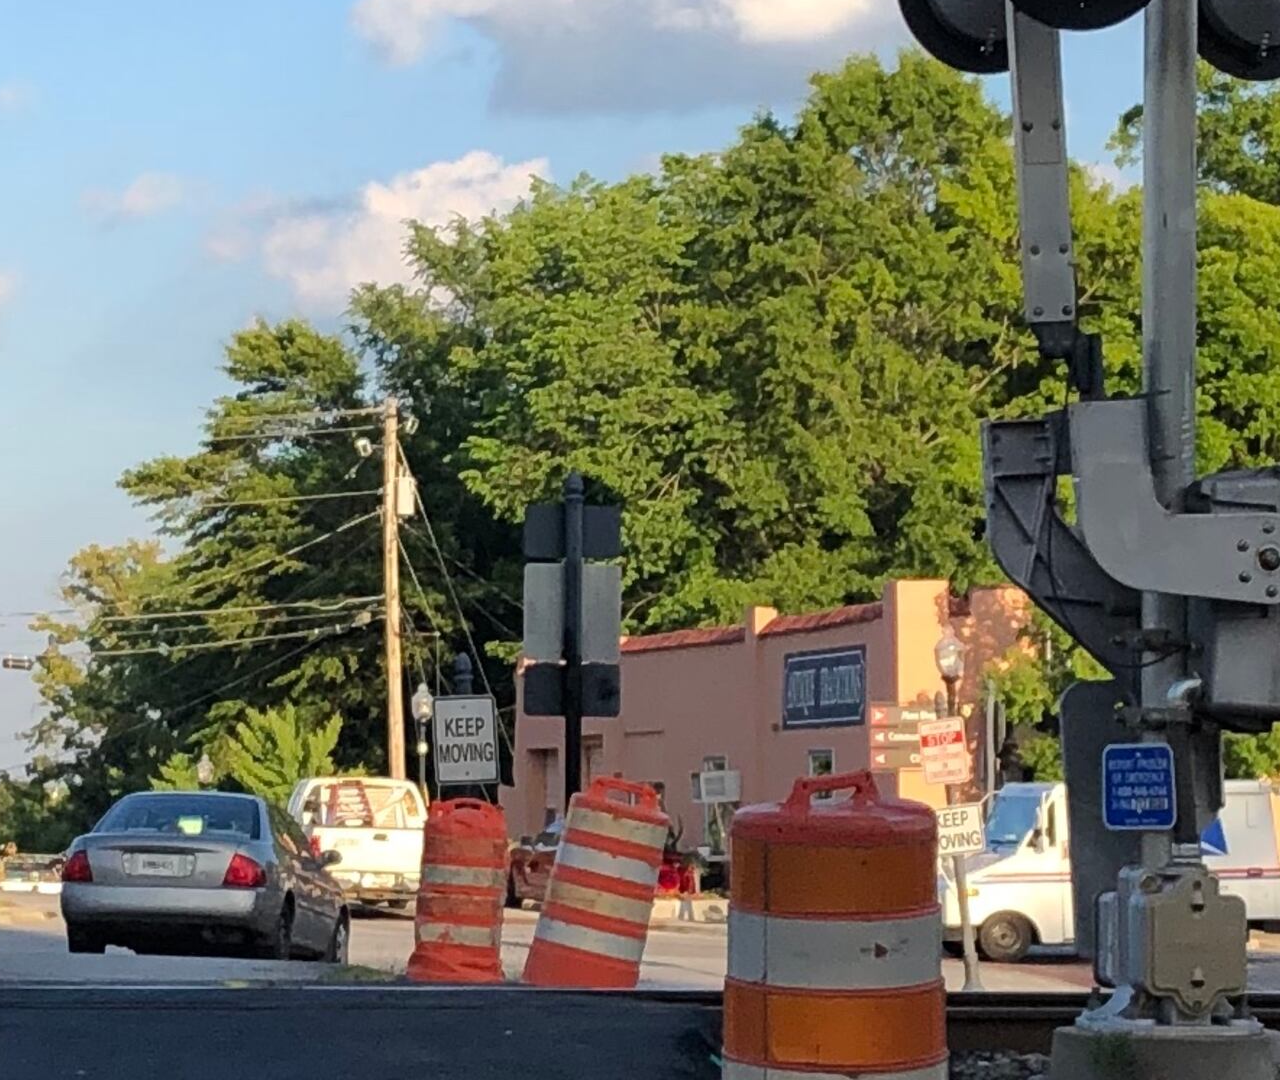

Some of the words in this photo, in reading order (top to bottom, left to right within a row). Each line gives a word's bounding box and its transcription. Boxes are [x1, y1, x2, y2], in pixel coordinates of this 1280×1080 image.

[444, 717, 485, 738] KEEP
[927, 732, 957, 746] STOP
[439, 742, 494, 763] MOVING
[938, 830, 982, 851] OVING
